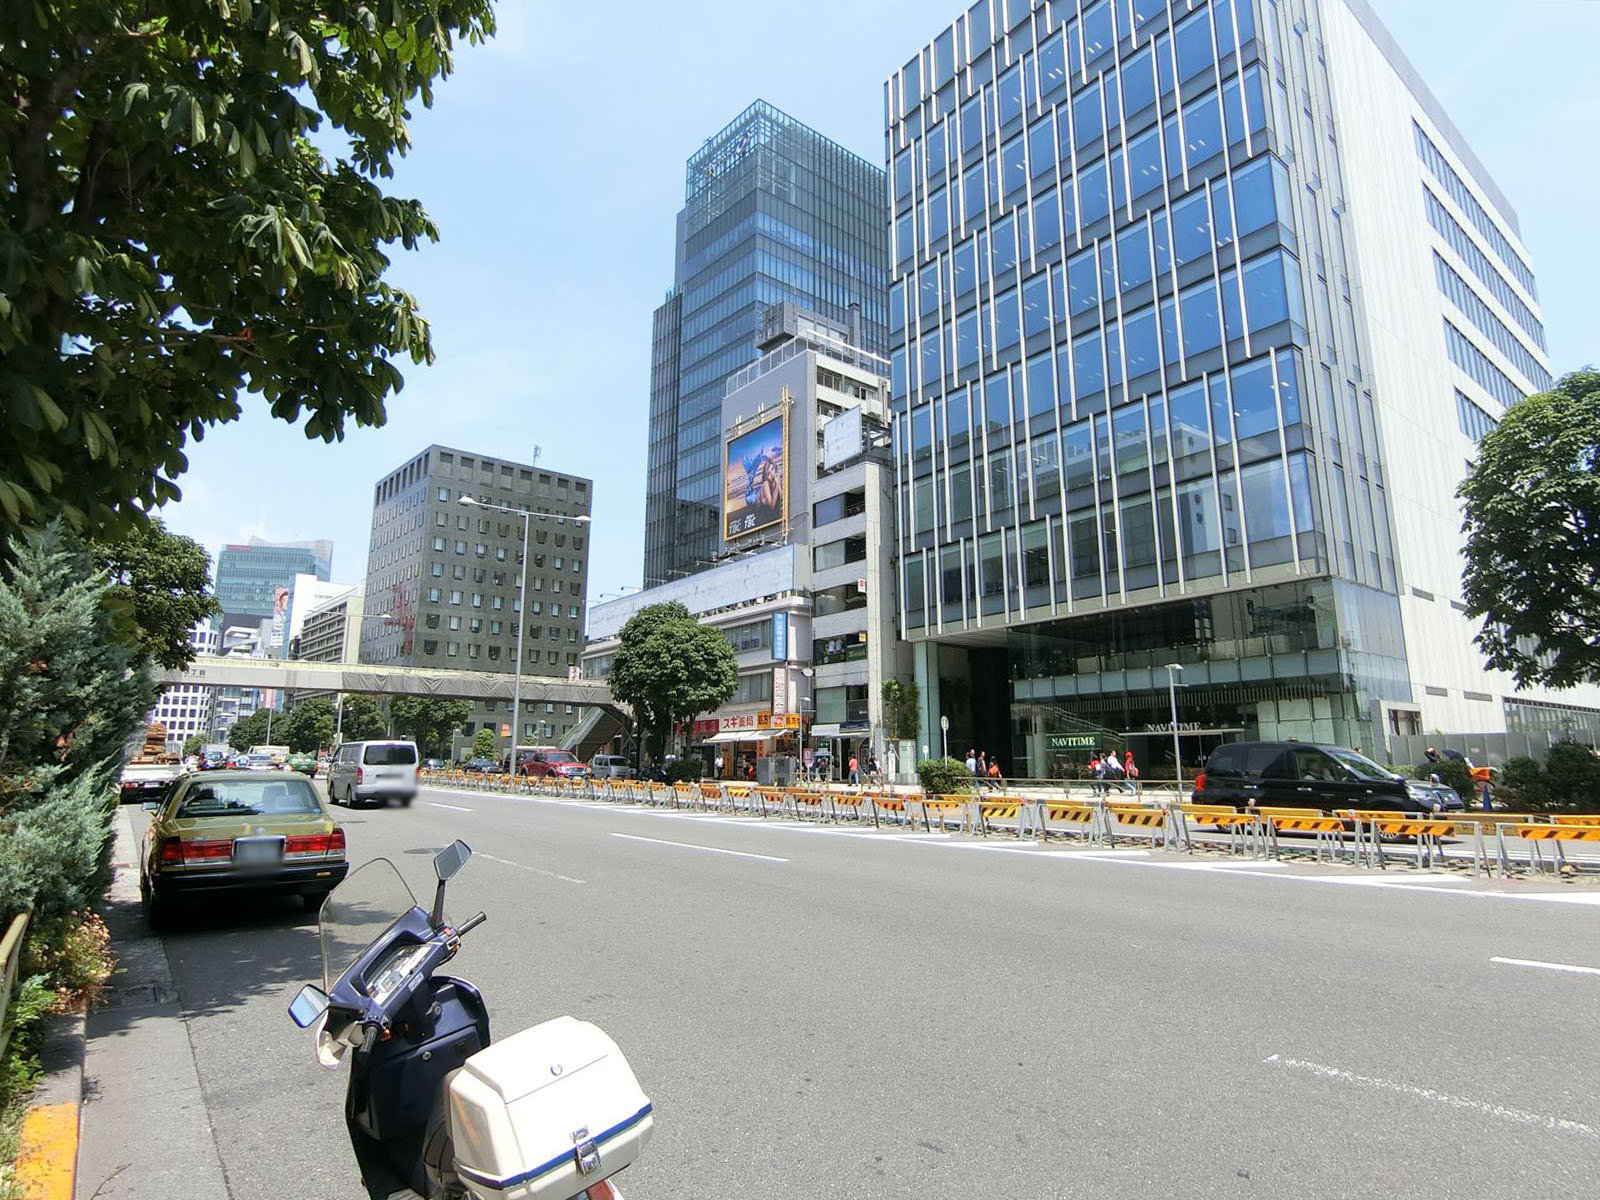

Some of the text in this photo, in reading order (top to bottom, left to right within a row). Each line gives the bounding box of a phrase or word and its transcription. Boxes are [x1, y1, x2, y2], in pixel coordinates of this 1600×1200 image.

[723, 713, 754, 729] スギ薬局
[1051, 736, 1096, 747] NAVITIME
